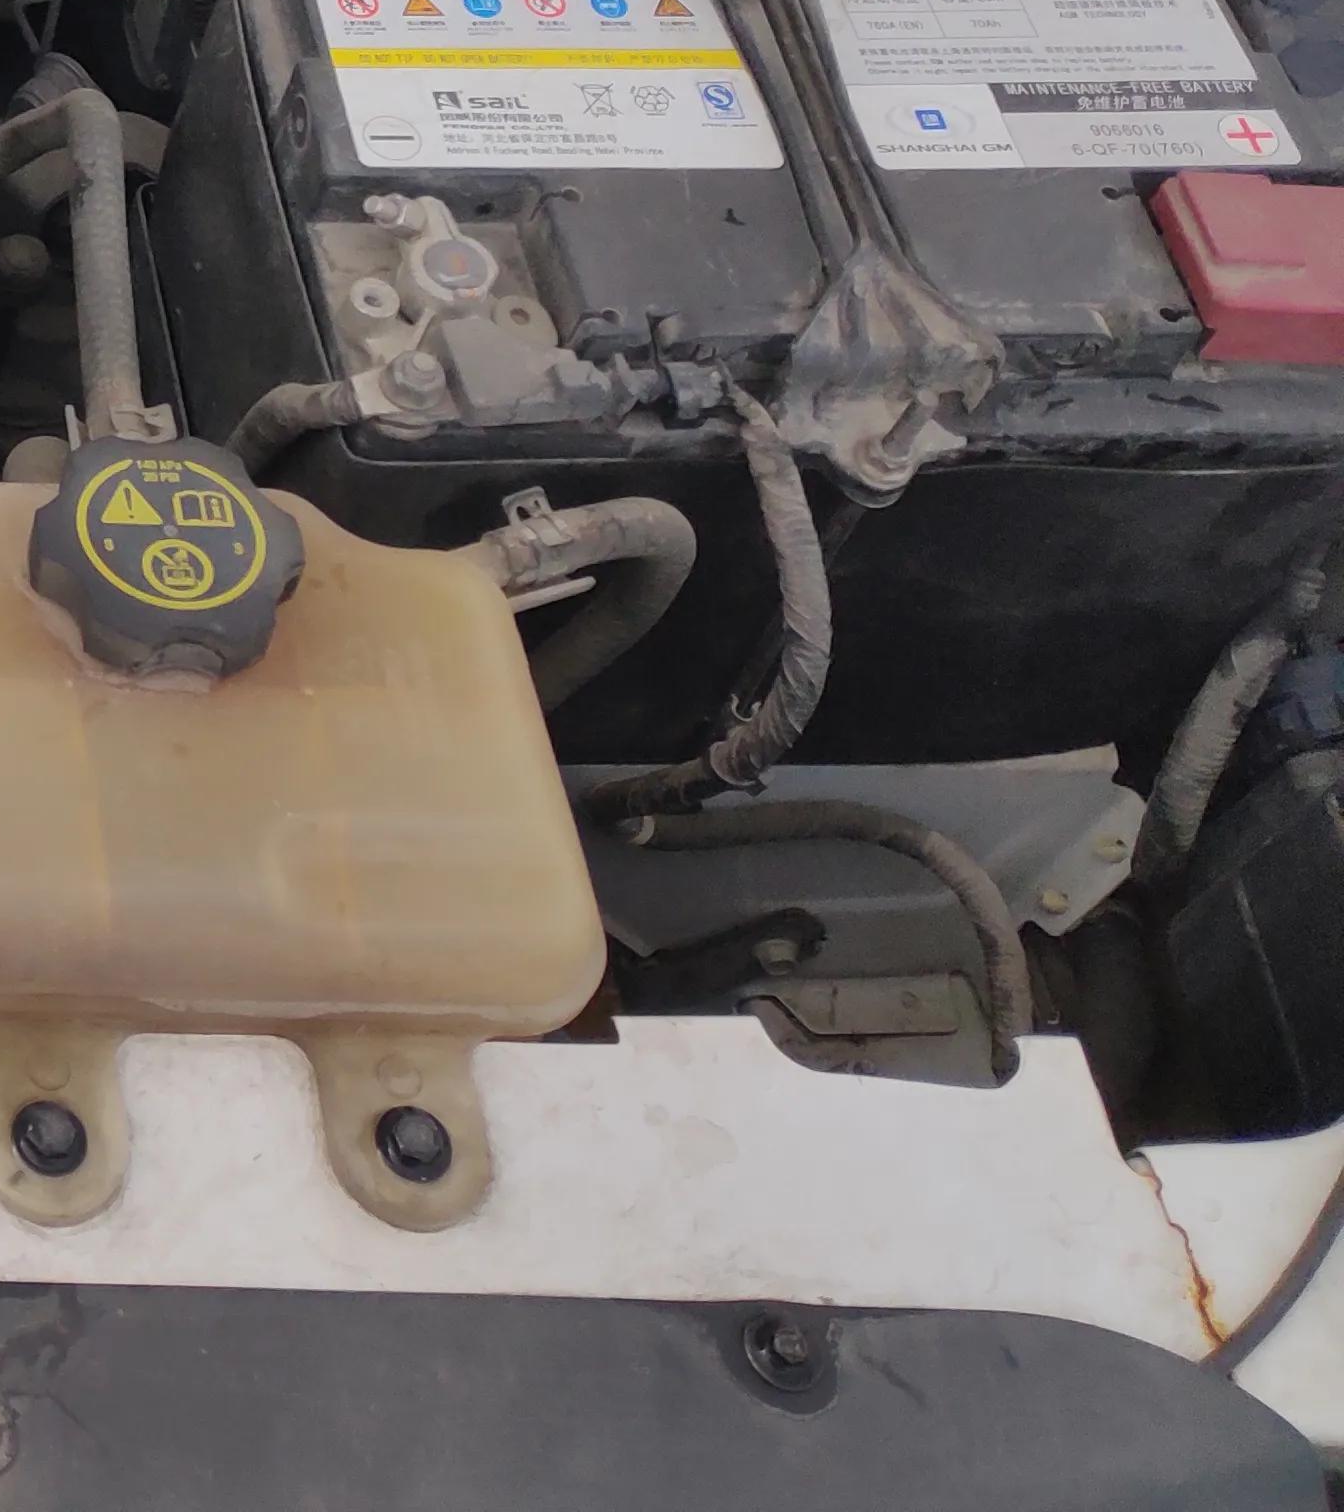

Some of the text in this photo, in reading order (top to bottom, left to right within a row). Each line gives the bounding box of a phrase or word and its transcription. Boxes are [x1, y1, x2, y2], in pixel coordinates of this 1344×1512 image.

[1180, 80, 1254, 95] BATTERY
[1076, 95, 1186, 111] 免维护蓄电池
[876, 143, 1014, 154] SHANGHAI GM
